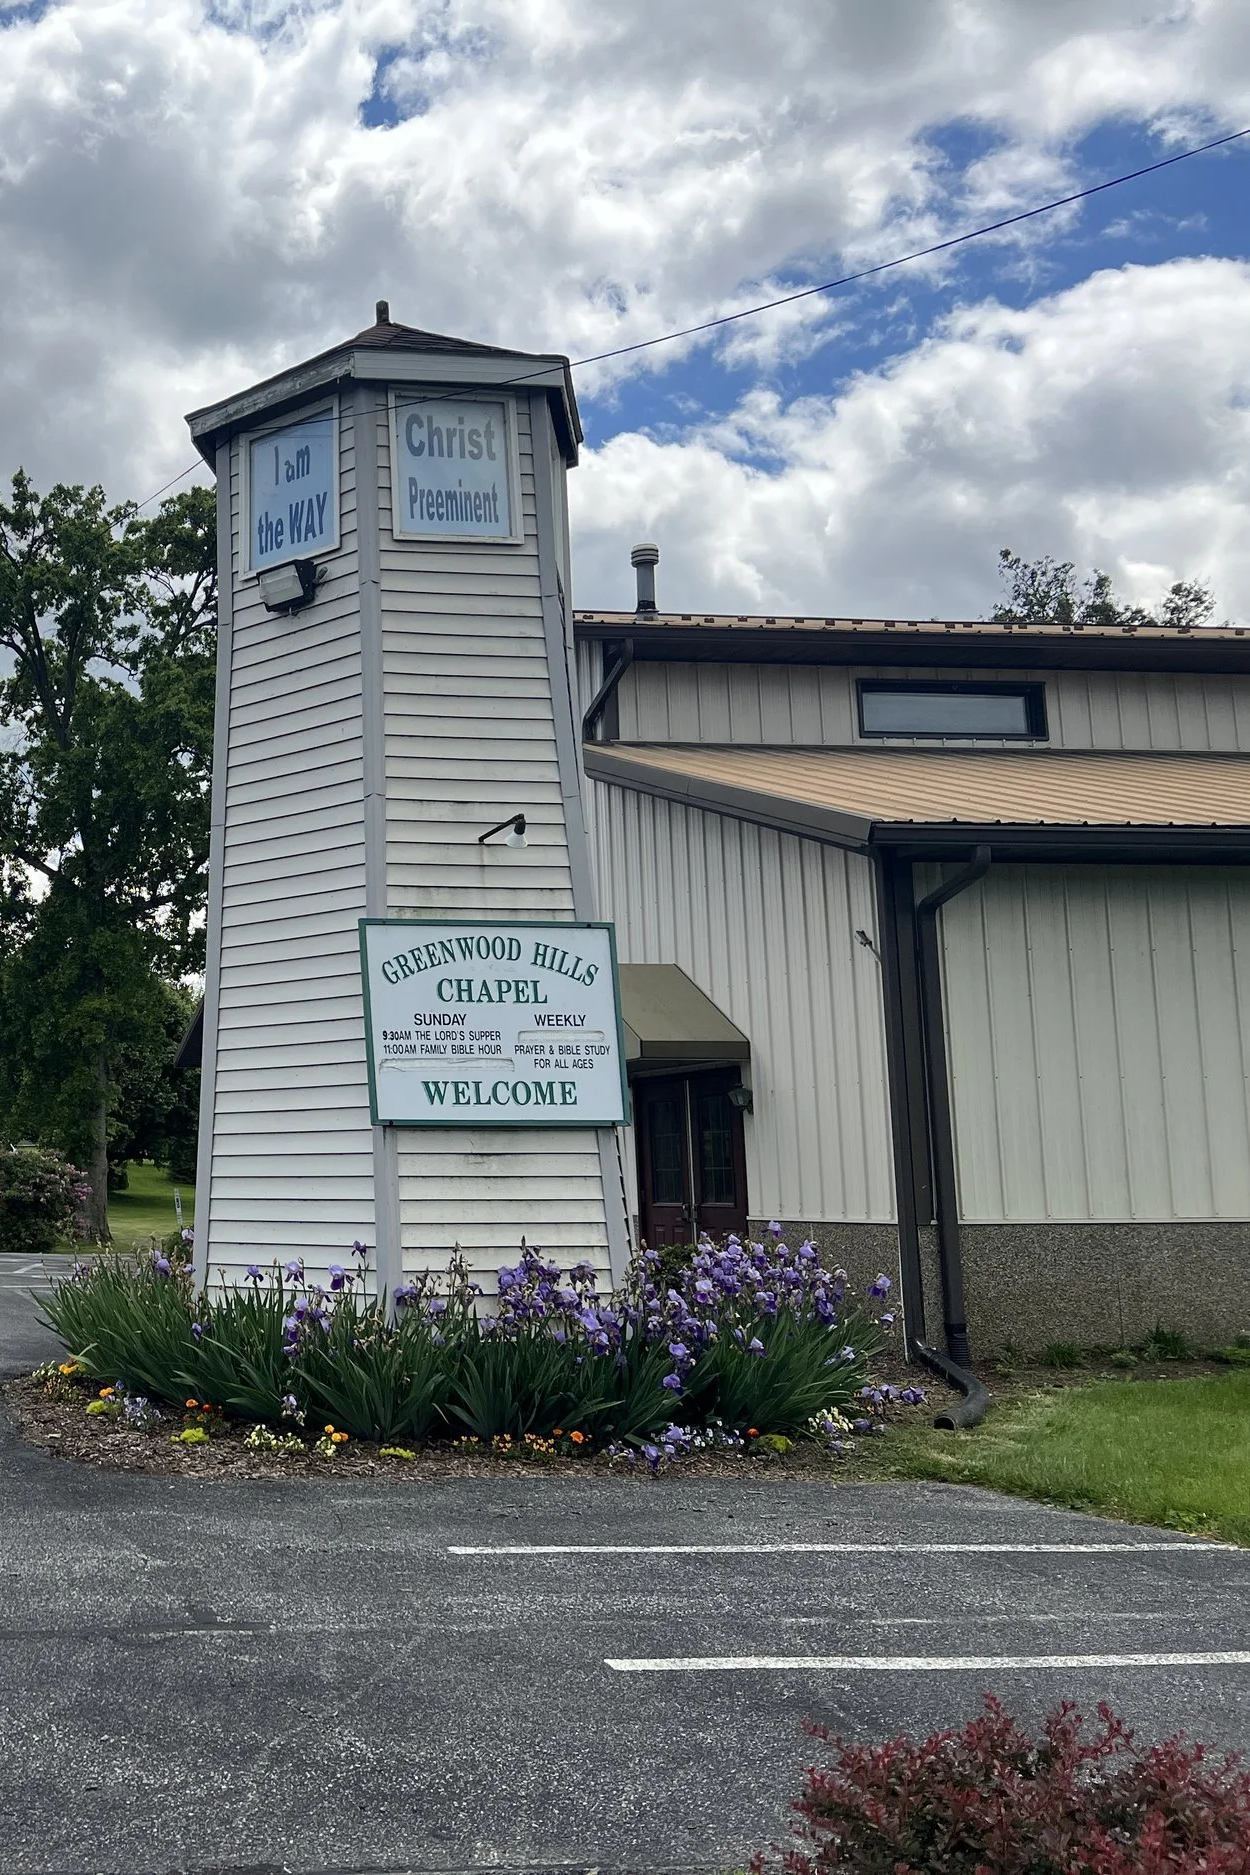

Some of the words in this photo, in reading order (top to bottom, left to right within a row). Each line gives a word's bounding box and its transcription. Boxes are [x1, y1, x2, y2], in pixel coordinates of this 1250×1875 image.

[405, 413, 497, 461] Christ
[274, 446, 280, 486] I
[284, 444, 310, 483] am
[408, 477, 499, 523] Preeminent
[258, 512, 284, 555] the
[288, 492, 328, 544] WAY
[381, 935, 522, 985] GREENWOOD
[531, 942, 600, 987] HILLS
[436, 978, 548, 1004] CHAPEL
[414, 1013, 467, 1026] SUNDAY
[534, 1014, 586, 1027] WEEKLY
[415, 1031, 432, 1040] THE
[435, 1030, 465, 1041] LORD'S
[468, 1031, 501, 1041] SUPPER
[384, 1044, 417, 1054] 11:00AM
[420, 1044, 447, 1054] FAMILY
[451, 1044, 474, 1054] BIBLE
[478, 1044, 502, 1054] HOUR
[515, 1045, 545, 1055] PRAYER
[549, 1045, 555, 1055] &
[558, 1045, 581, 1055] BIBLE
[585, 1045, 610, 1055] STUDY
[534, 1059, 551, 1069] FOR
[555, 1059, 569, 1069] ALL
[573, 1059, 593, 1069] AGES
[421, 1080, 577, 1106] WELCOME
